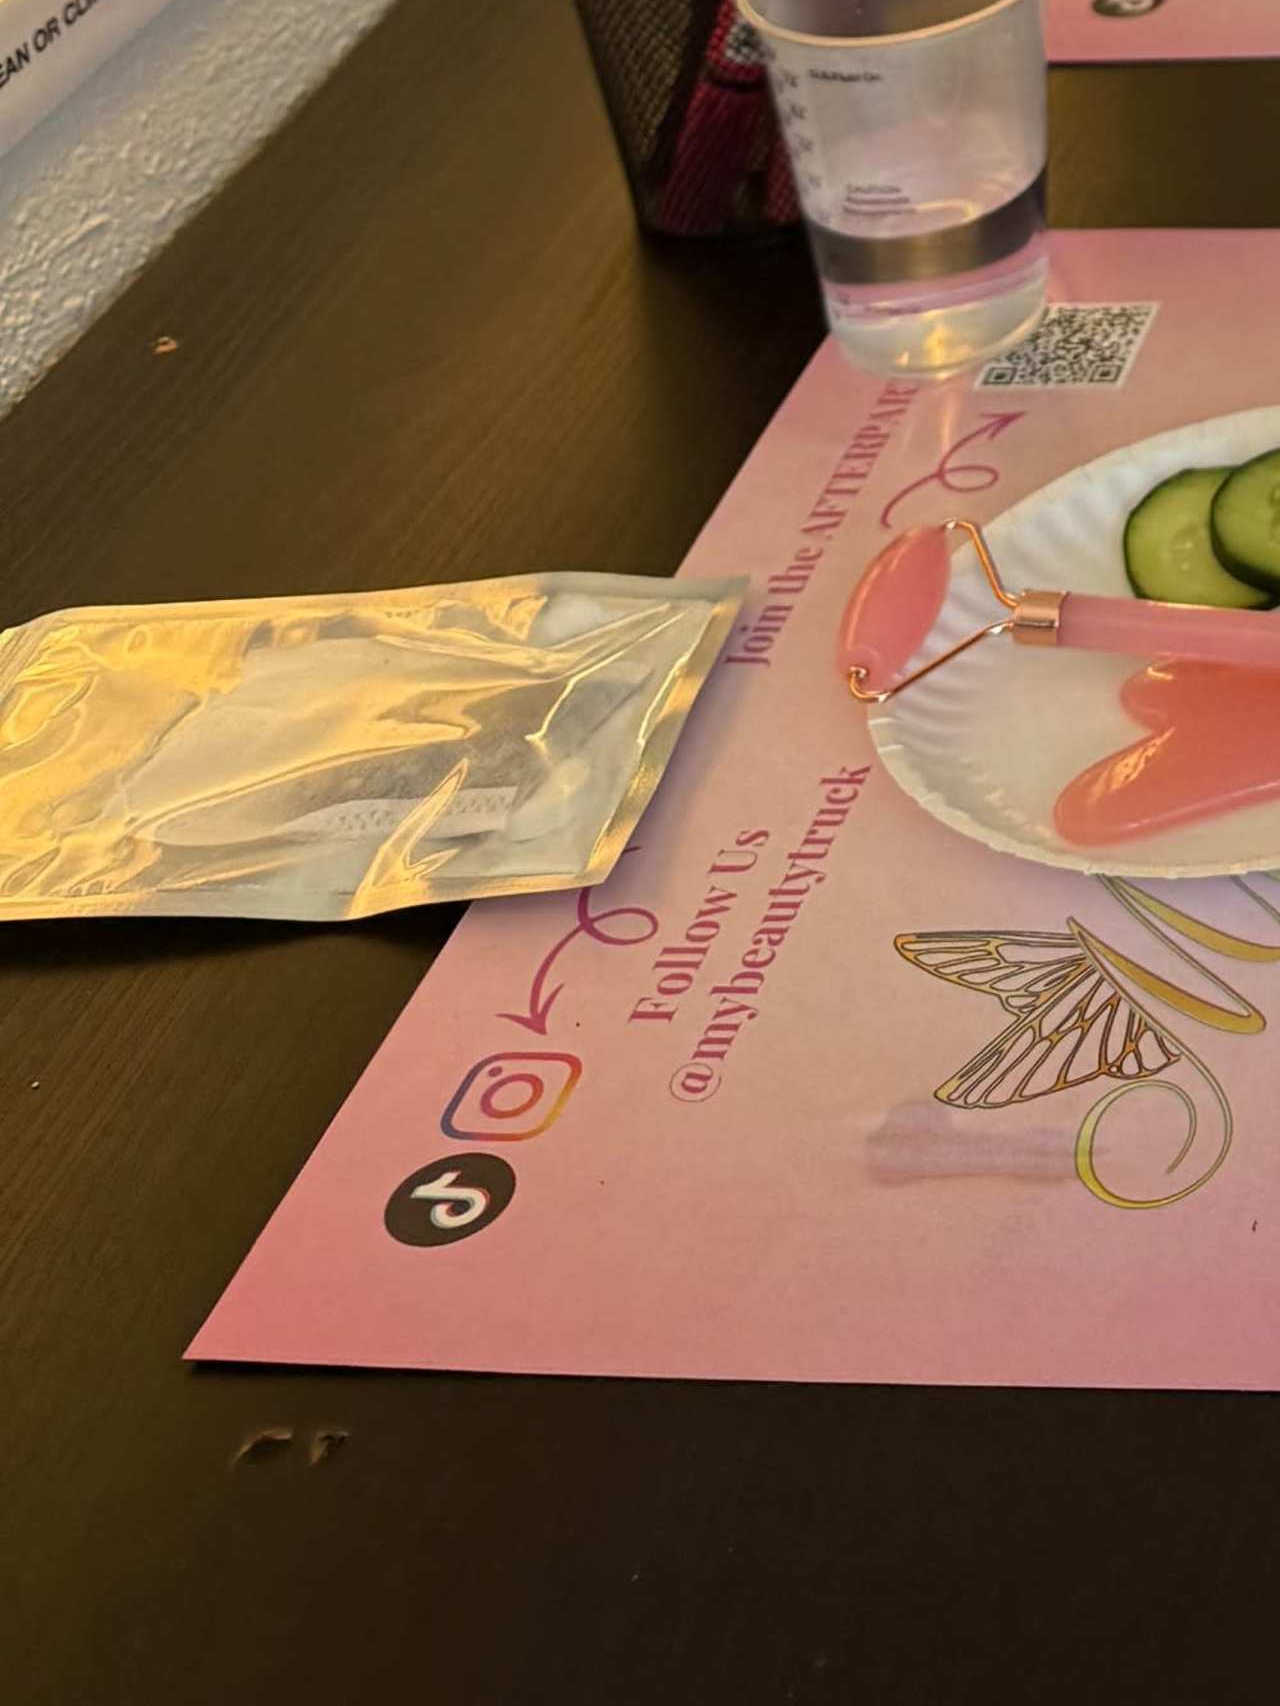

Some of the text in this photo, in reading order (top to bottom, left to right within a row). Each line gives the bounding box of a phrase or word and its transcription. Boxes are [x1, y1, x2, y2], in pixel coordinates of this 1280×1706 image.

[33, 17, 62, 53] OR
[725, 380, 919, 668] Join the AFTERPAR
[627, 829, 770, 1025] Follow Us
[669, 765, 872, 1103] @mybeautytruck
